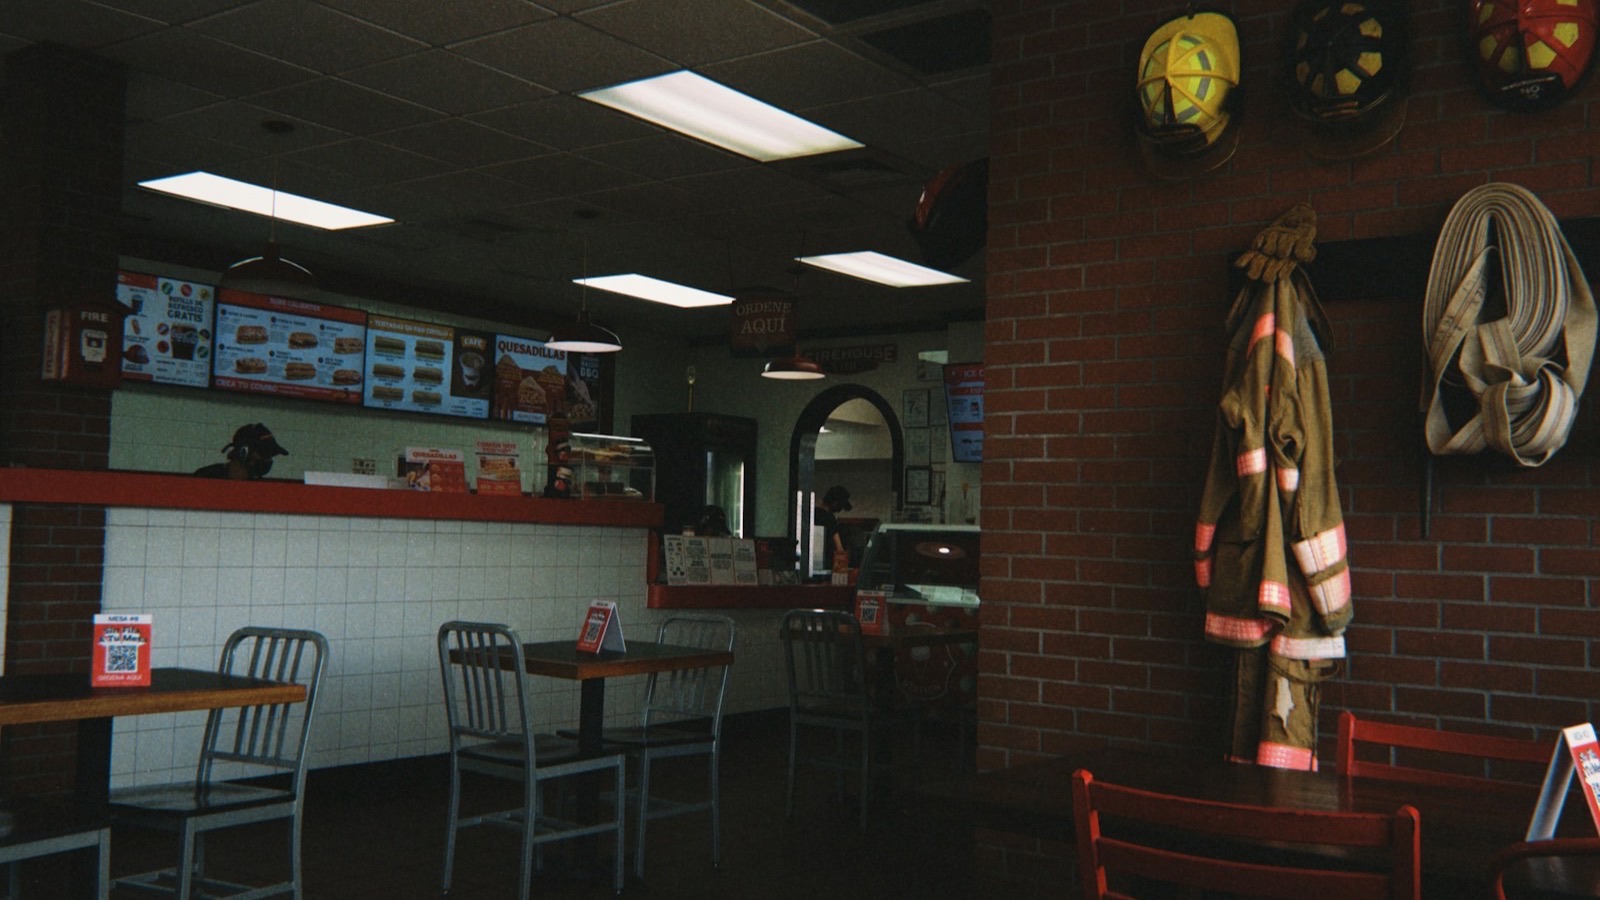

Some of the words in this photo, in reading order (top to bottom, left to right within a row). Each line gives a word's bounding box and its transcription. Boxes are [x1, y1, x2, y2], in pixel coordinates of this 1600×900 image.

[168, 303, 204, 313] REFRESCO
[736, 301, 792, 316] ORDENE
[80, 311, 108, 323] FIRE
[167, 310, 203, 322] GRATIS
[498, 340, 565, 360] QUESADILLAS
[413, 451, 456, 460] QUESADILLAS
[123, 635, 147, 643] Mesa
